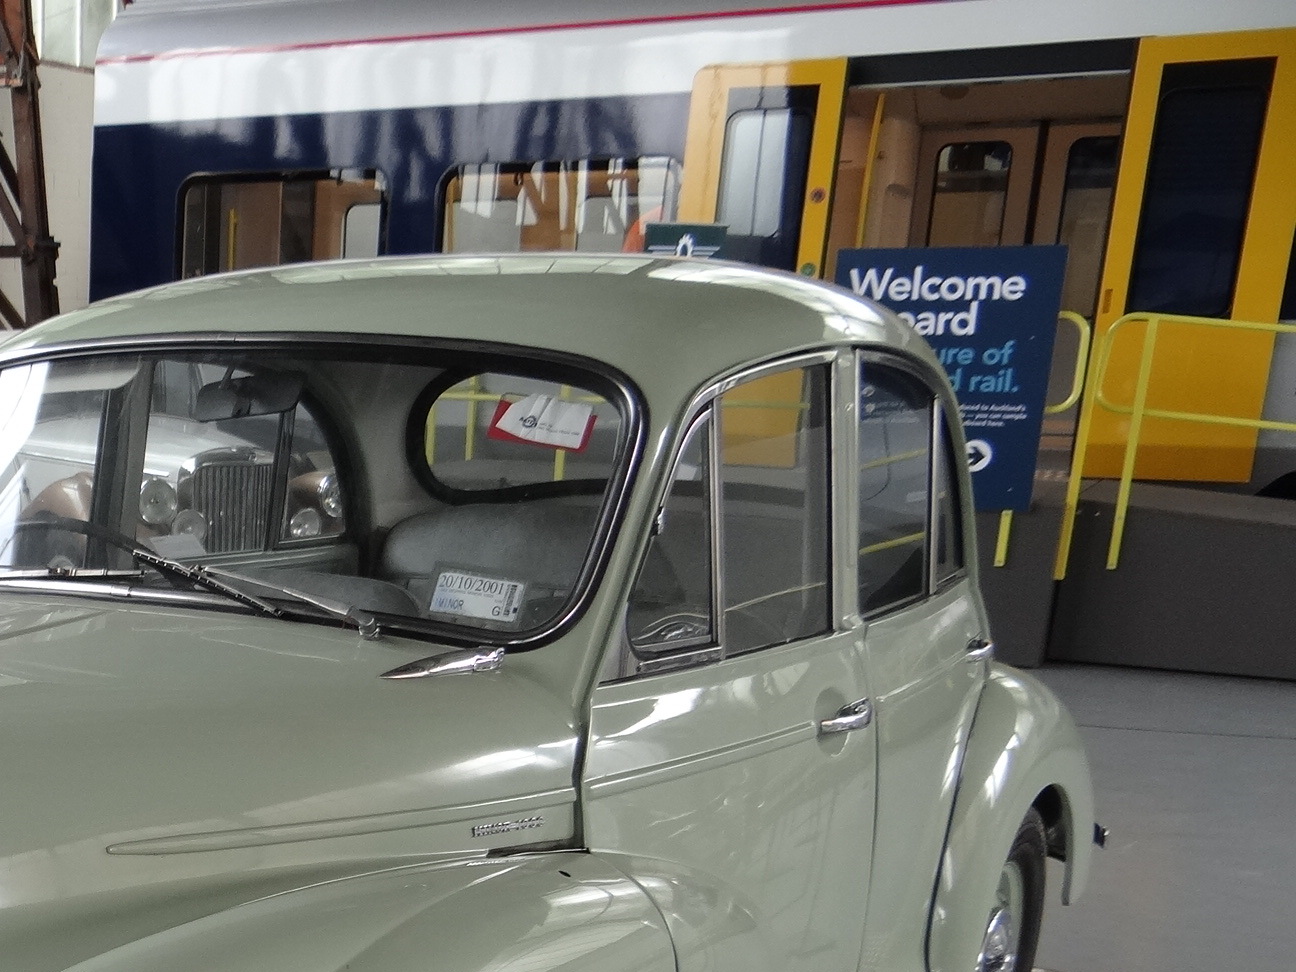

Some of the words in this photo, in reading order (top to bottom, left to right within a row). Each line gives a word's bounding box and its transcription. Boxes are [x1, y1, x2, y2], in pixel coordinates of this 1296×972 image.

[850, 265, 1026, 301] Welcome
[982, 340, 1016, 365] of
[968, 368, 1019, 393] rail.
[438, 574, 504, 595] 20/10/2001
[491, 605, 501, 616] G
